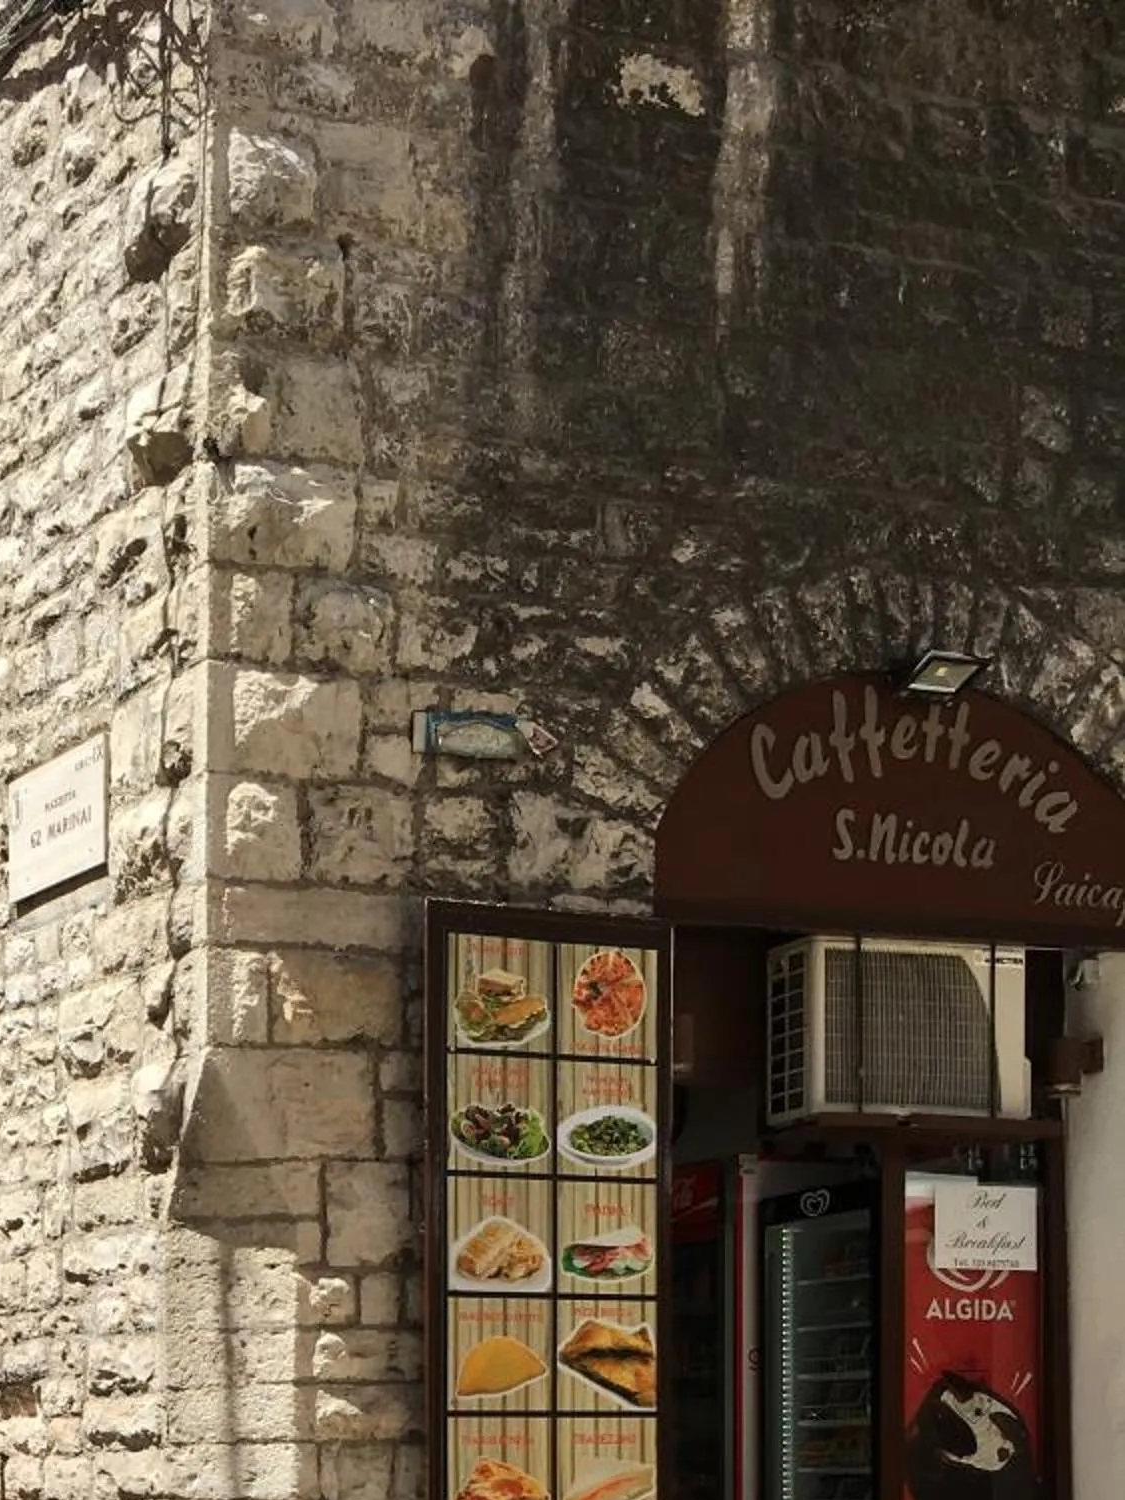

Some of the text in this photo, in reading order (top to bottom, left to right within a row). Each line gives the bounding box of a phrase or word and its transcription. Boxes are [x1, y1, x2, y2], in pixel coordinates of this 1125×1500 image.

[749, 685, 1079, 834] Caffetteria
[967, 1191, 1007, 1210] Bed
[945, 1231, 1026, 1255] Breakfast
[924, 1297, 1013, 1321] ALGIDA
